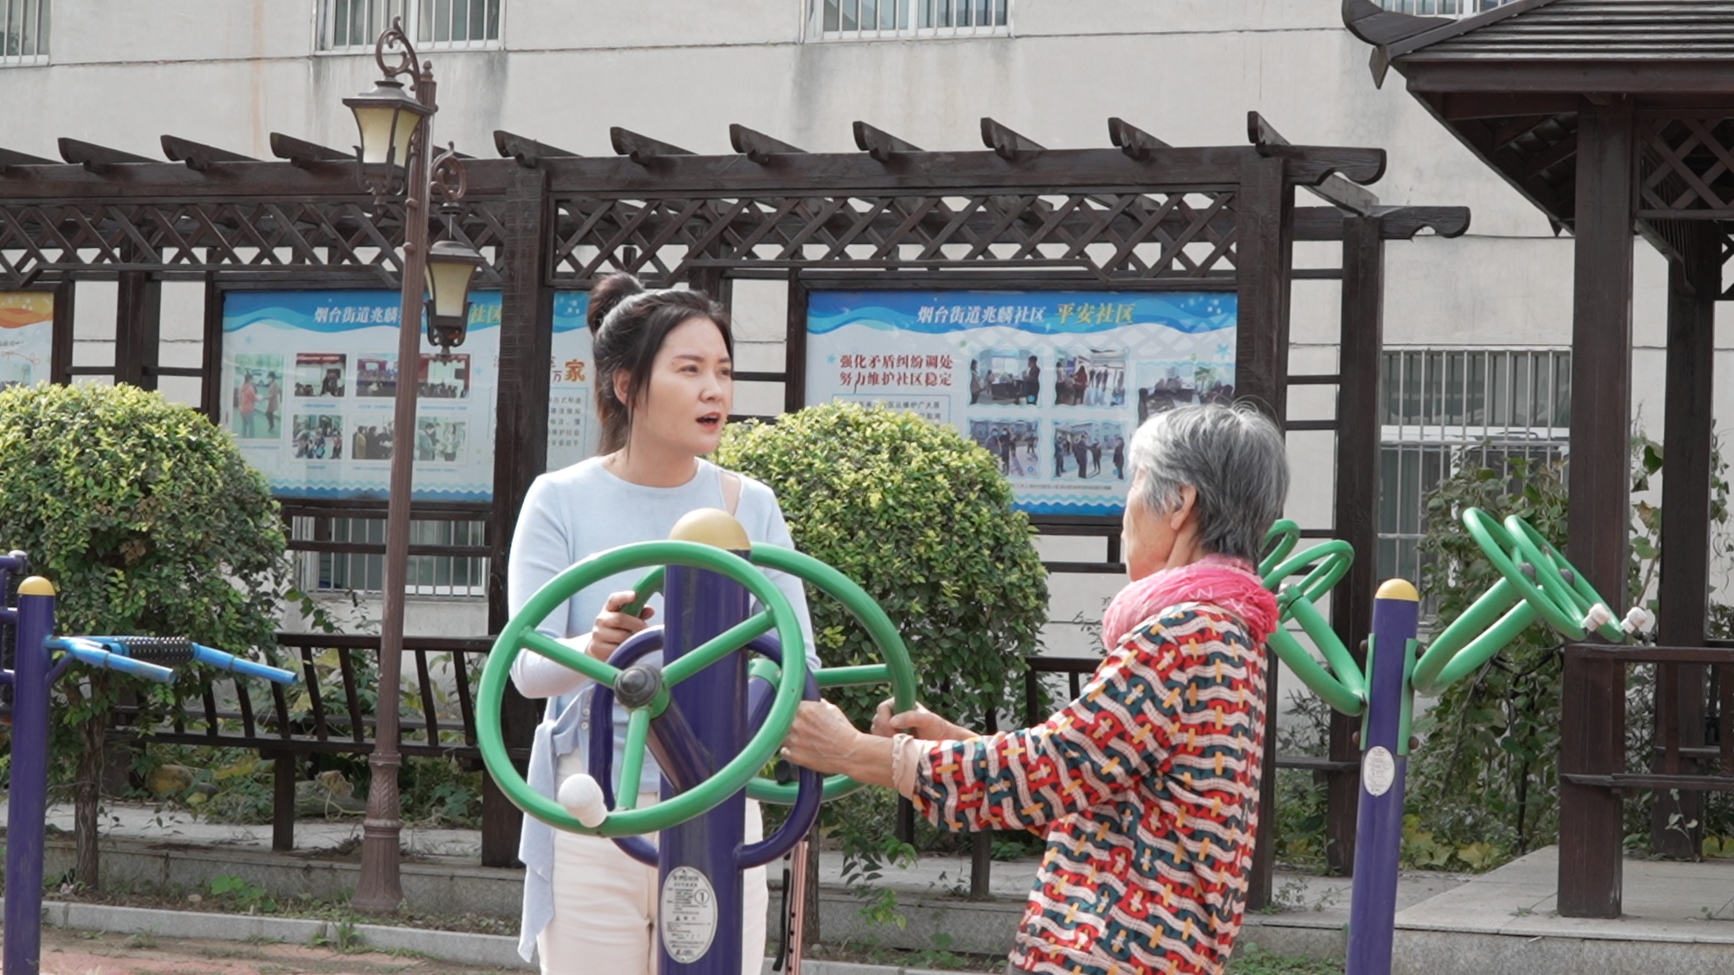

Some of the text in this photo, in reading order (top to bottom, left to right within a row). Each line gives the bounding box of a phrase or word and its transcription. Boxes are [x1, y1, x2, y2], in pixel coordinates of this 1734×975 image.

[314, 306, 401, 324] 烟台街道兆麟
[917, 303, 1137, 325] 烟台街道兆麟社区 平安社区
[840, 354, 954, 369] 强化矛盾纠纷调处
[840, 371, 952, 387] 努力维护社区稳定
